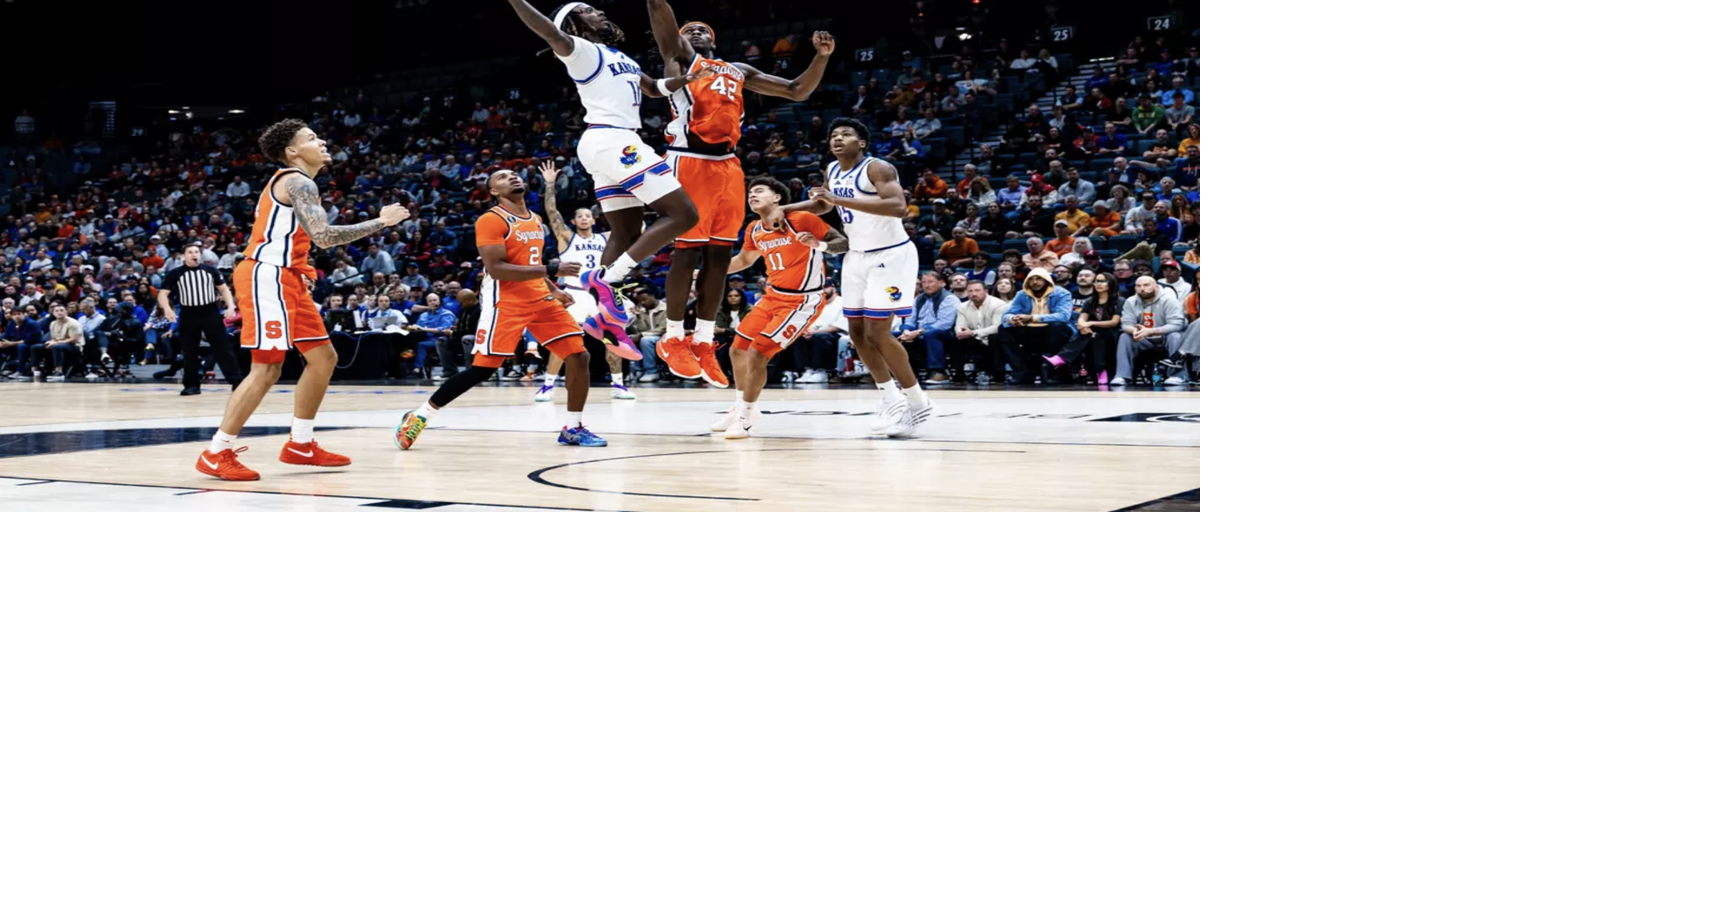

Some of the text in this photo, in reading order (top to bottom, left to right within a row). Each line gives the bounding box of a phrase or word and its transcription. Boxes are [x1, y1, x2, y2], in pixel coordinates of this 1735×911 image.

[1154, 19, 1169, 30] 24
[1053, 30, 1068, 41] 25
[861, 51, 873, 61] 25
[710, 76, 737, 101] 42
[833, 187, 855, 199] NSAS
[758, 236, 793, 253] Syracuse
[529, 246, 540, 265] 2
[586, 254, 596, 268] 3
[768, 252, 786, 271] 11
[265, 320, 283, 339] S
[475, 328, 487, 345] S
[782, 324, 798, 340] S
